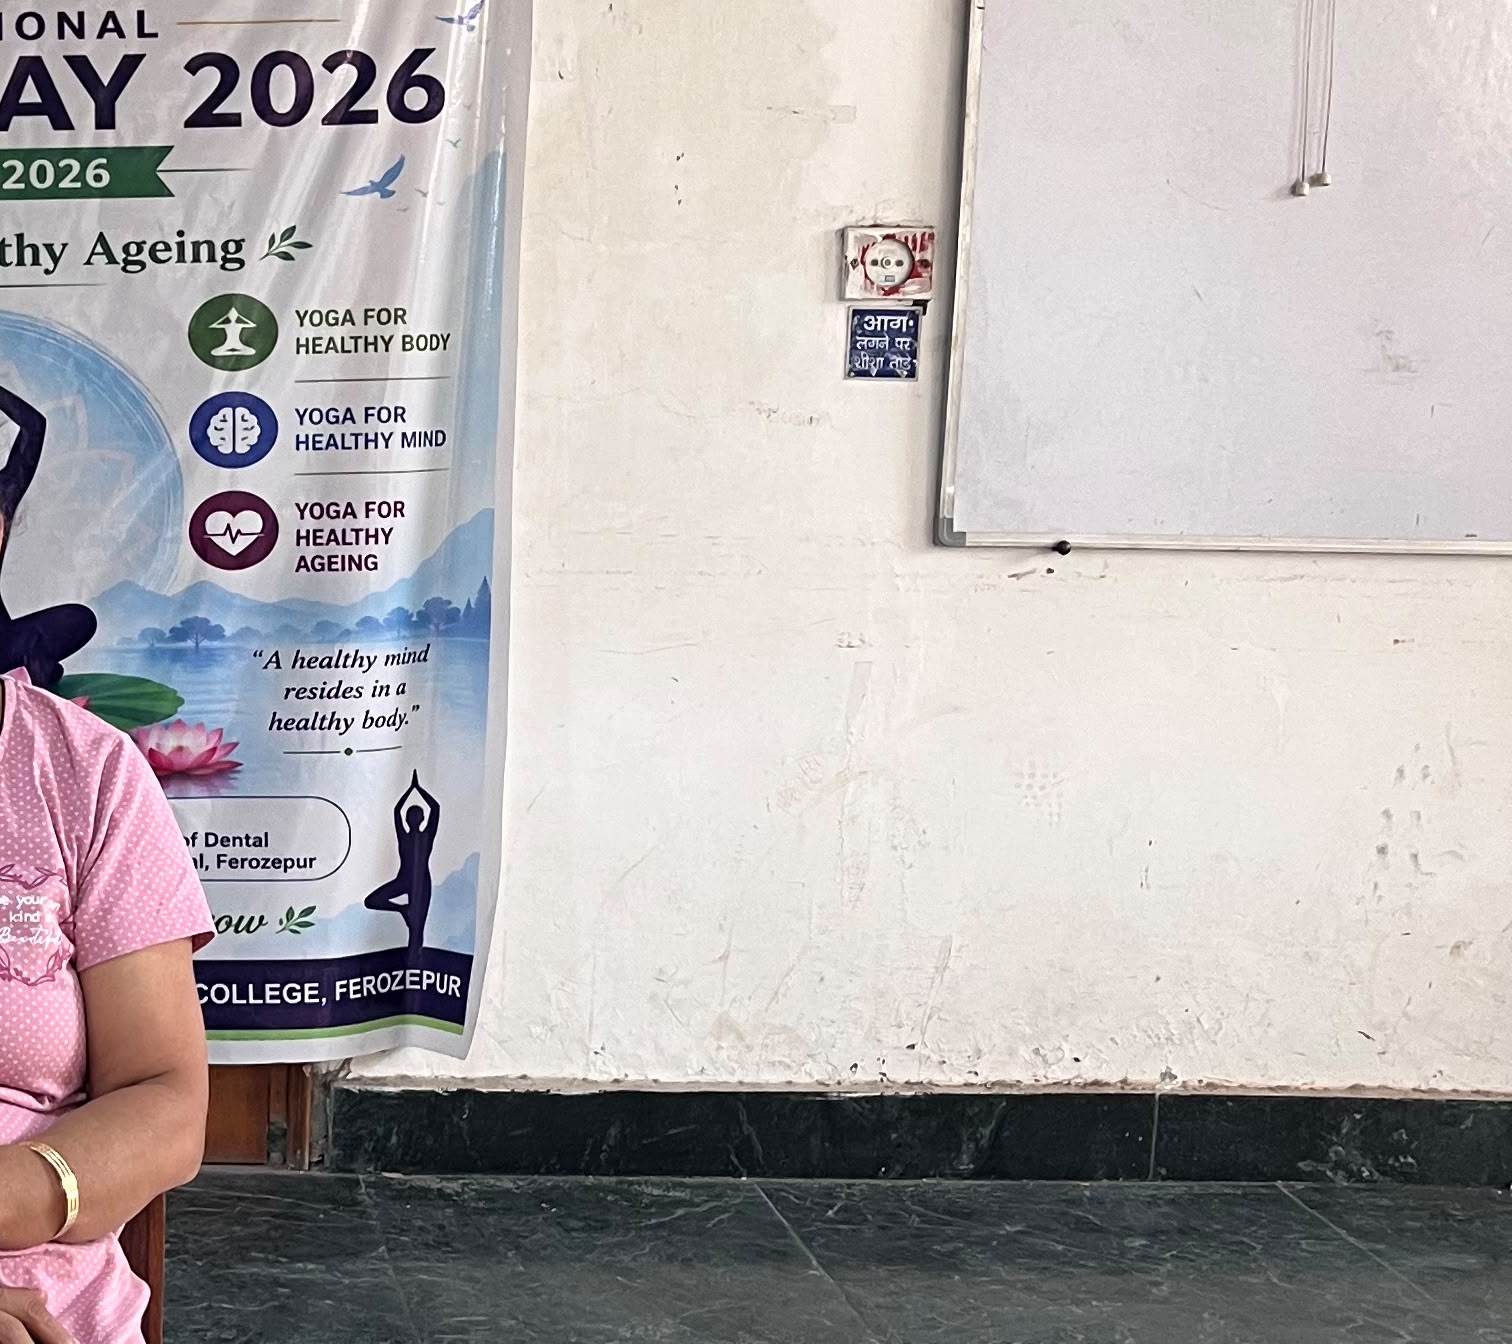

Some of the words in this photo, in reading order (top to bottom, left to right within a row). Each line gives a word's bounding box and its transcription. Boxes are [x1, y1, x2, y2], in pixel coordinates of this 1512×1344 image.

[183, 47, 445, 128] 2026
[1, 157, 111, 189] 2026
[83, 229, 246, 274] Ageing
[295, 308, 356, 327] YOGA
[363, 307, 407, 326] FOR
[863, 315, 909, 332] आग
[295, 334, 395, 355] HEALTHY
[401, 332, 451, 352] BODY
[856, 332, 890, 351] लगने
[894, 336, 913, 351] पर
[295, 407, 356, 426] YOGA
[364, 405, 407, 424] FOR
[295, 432, 395, 451] HEALTHY
[400, 429, 447, 449] MIND
[295, 501, 358, 520] YOGA
[364, 500, 405, 518] FOR
[295, 526, 394, 547] HEALTHY
[295, 553, 379, 572] AGEING
[291, 649, 378, 674] healthy
[384, 643, 431, 668] mind
[283, 680, 364, 701] resides
[371, 679, 390, 698] in
[395, 682, 407, 696] a
[268, 711, 355, 736] healthy
[204, 831, 269, 848] Dental
[216, 853, 317, 873] Ferozepur
[334, 969, 461, 1002] FEROZEPUR
